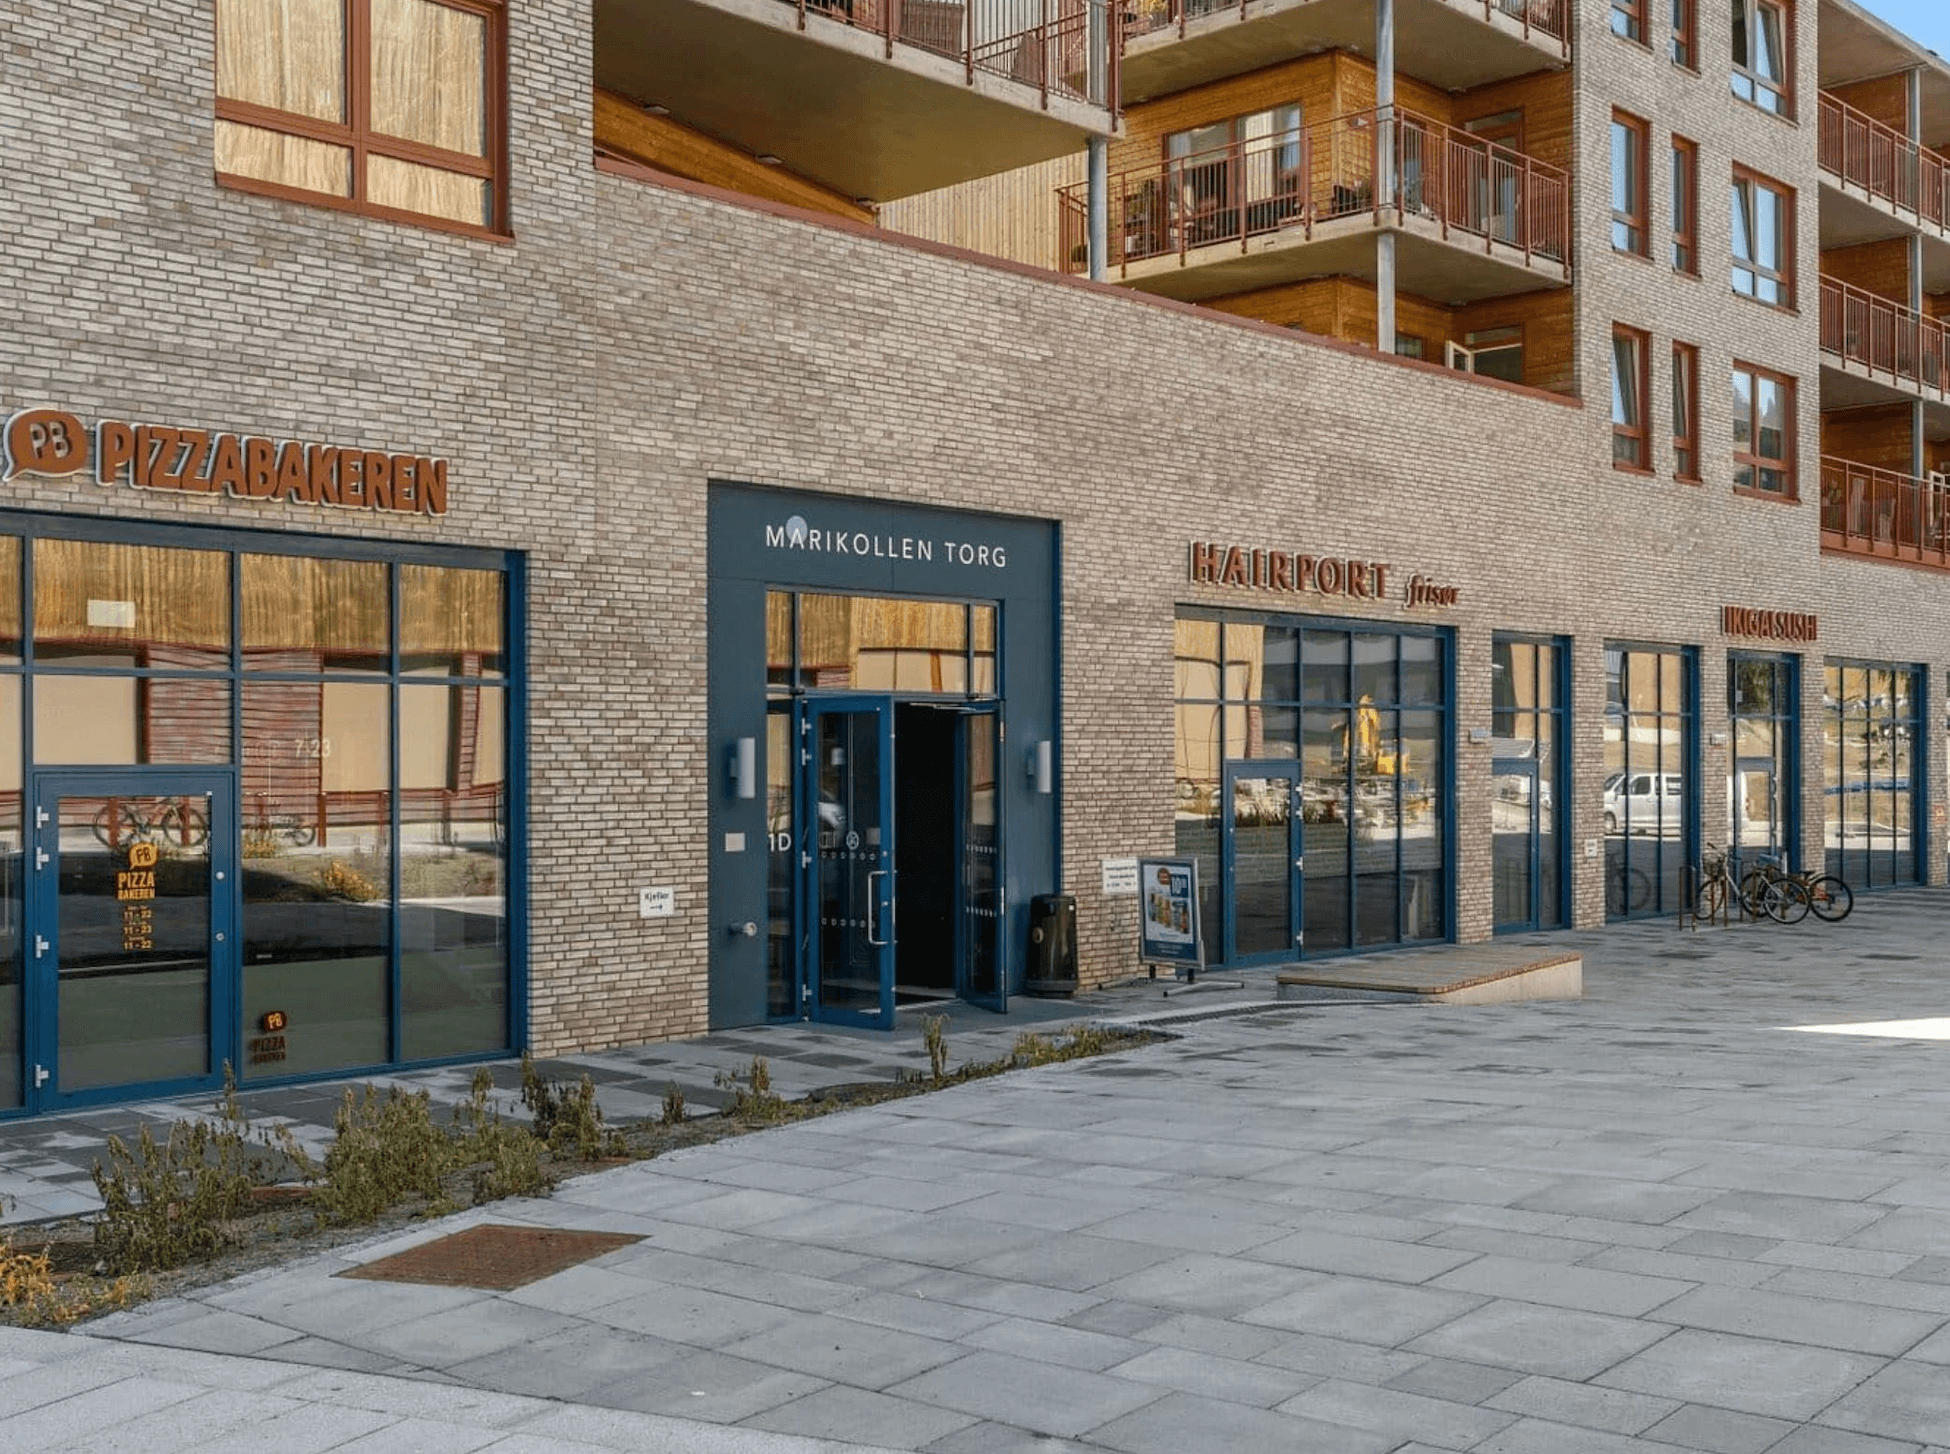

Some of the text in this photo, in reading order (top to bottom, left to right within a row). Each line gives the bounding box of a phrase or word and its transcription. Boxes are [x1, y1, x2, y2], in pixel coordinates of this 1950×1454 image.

[29, 421, 73, 459] PB
[96, 418, 448, 516] PIZZABAKEREN
[765, 524, 1007, 569] MARIKOLLEN TORG
[1189, 540, 1391, 600] HAIRPORT
[135, 847, 151, 864] PB
[768, 832, 792, 852] 1D
[117, 871, 155, 889] PIZZA
[268, 1012, 283, 1030] PB
